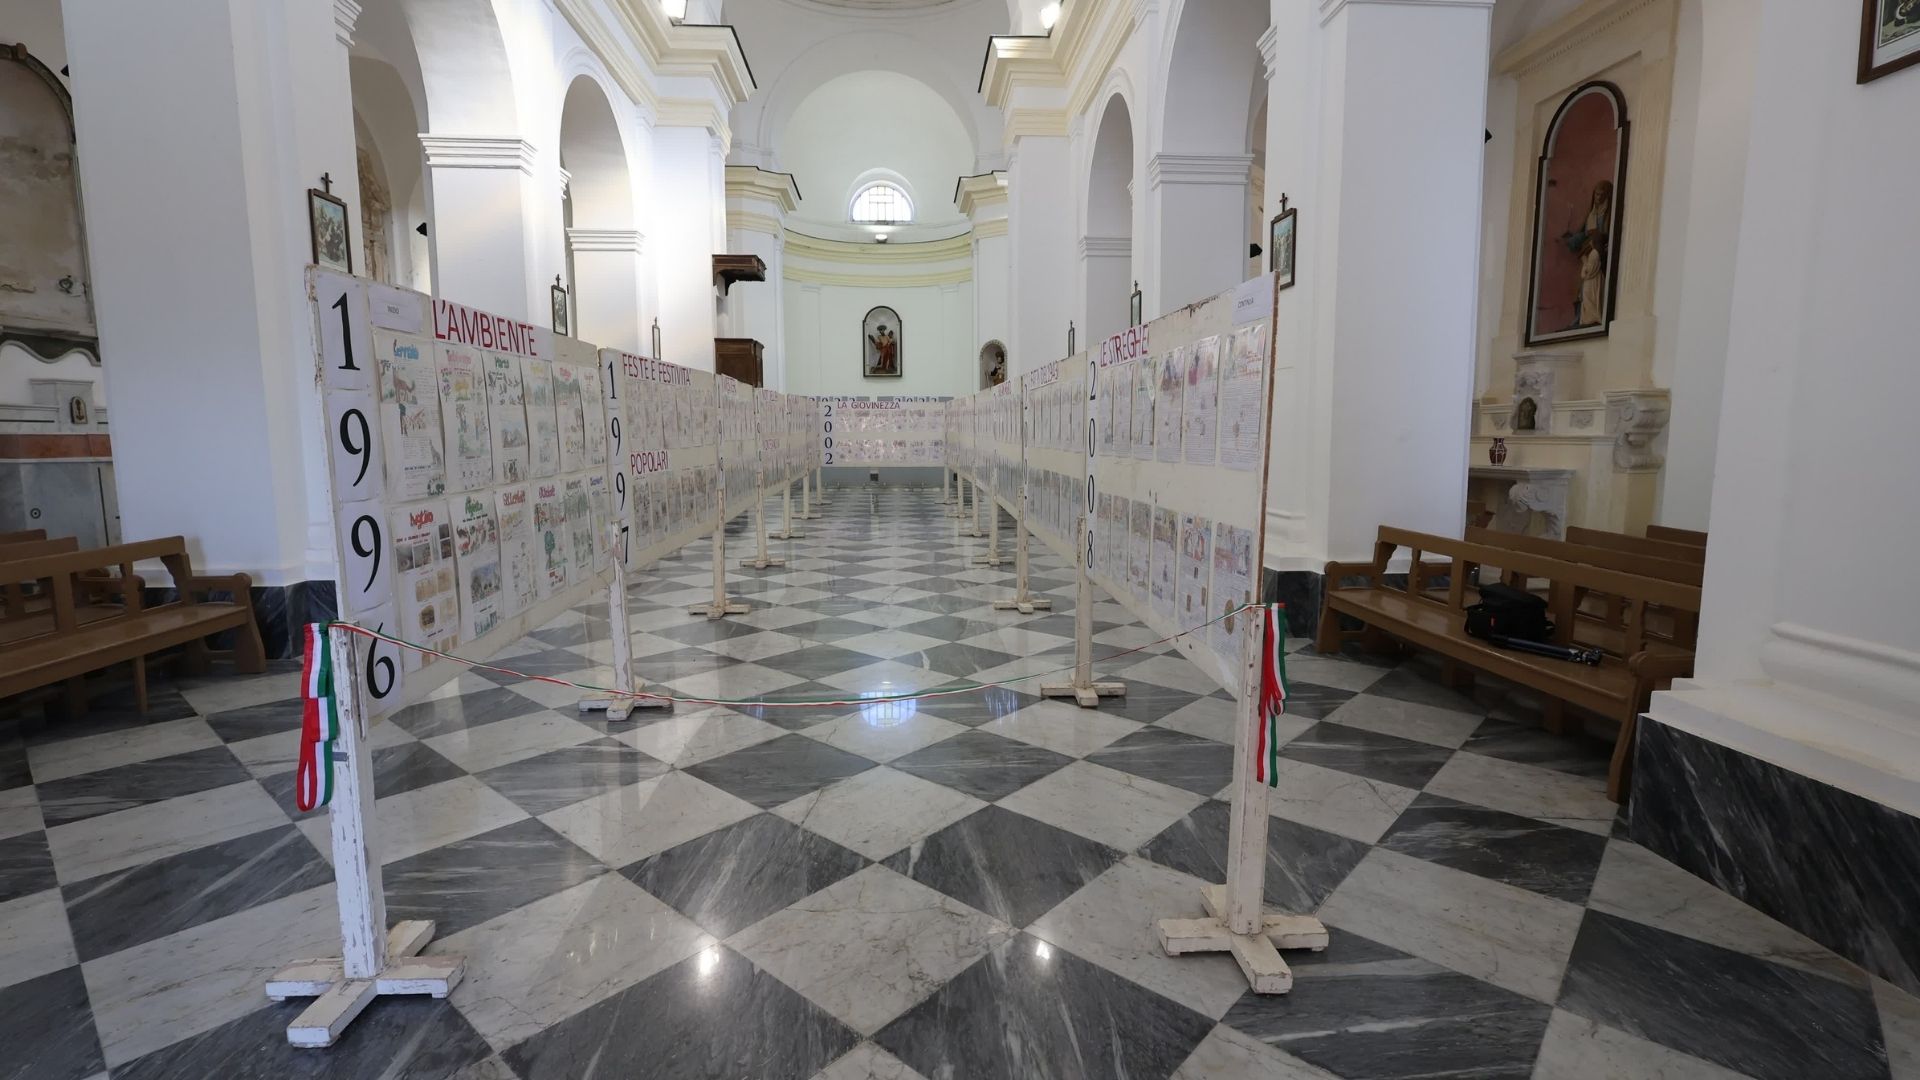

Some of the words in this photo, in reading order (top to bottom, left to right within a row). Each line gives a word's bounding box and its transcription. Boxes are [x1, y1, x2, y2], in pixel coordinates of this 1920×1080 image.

[431, 299, 537, 357] L'AMBIENTE
[1100, 341, 1107, 368] LE
[1109, 324, 1148, 364] STREGHE
[622, 353, 649, 379] FESTE
[651, 360, 656, 381] E
[837, 401, 848, 409] LA
[851, 401, 901, 410] GIOVINEZZA
[823, 405, 834, 465] 2002
[630, 451, 669, 475] POPOLARI
[1087, 361, 1096, 569] 2008
